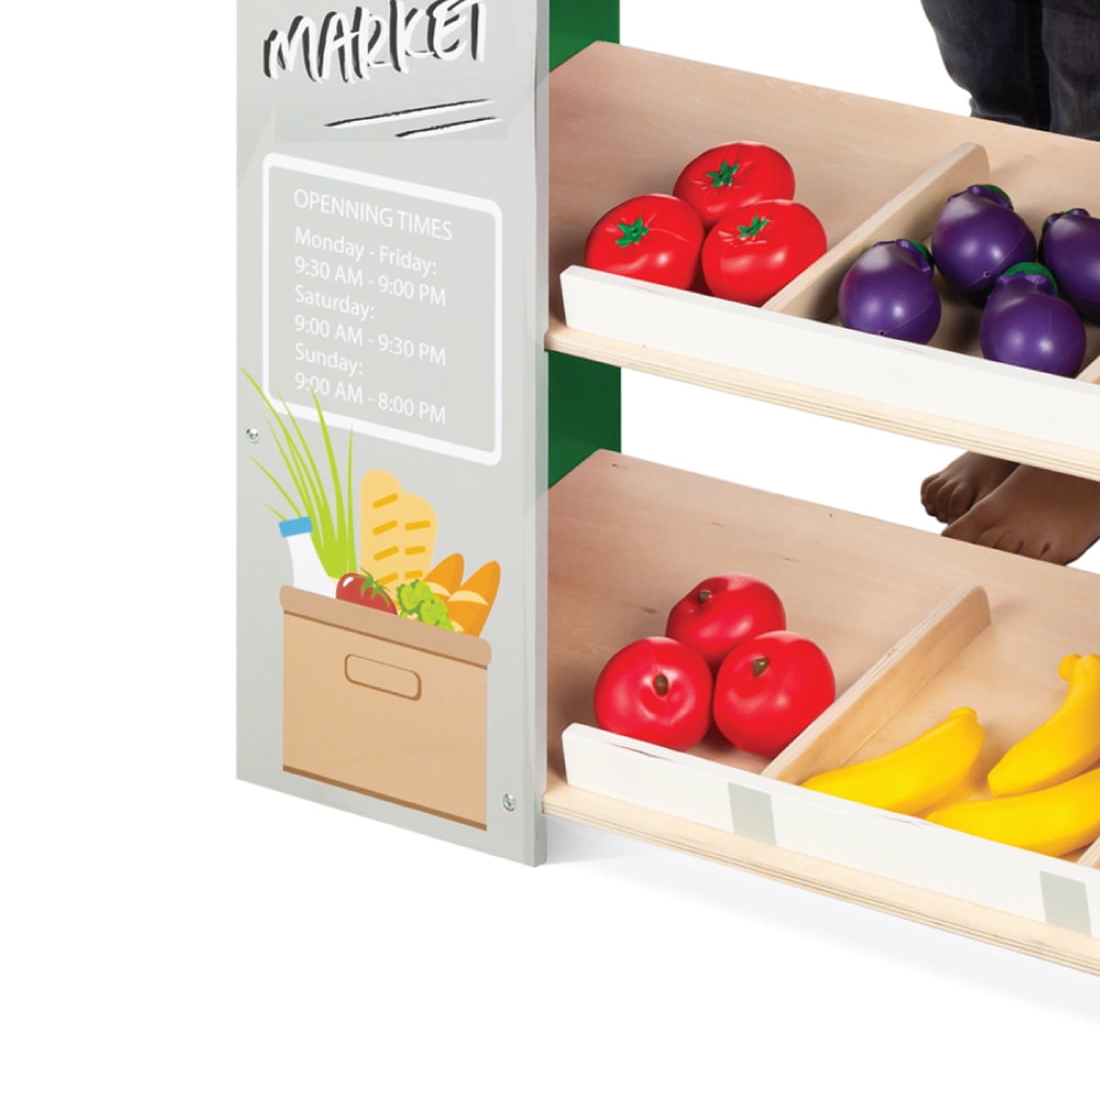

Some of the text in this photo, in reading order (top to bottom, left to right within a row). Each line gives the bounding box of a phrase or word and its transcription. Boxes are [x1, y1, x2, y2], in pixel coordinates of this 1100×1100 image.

[293, 188, 453, 241] OPENNING TIMES
[295, 226, 365, 262] Monday
[379, 245, 437, 277] Friday:
[295, 255, 331, 280] 9:30
[334, 264, 364, 288] AM
[378, 274, 415, 299] 9:00
[419, 283, 446, 308] PM
[295, 284, 375, 321] Saturday:
[295, 313, 331, 338] 9:00
[334, 323, 364, 347] AM
[378, 333, 415, 358] 9:30
[419, 342, 446, 367] PM
[295, 342, 363, 377] Sunday:
[295, 371, 331, 396] 9:00
[334, 381, 364, 405] AM
[378, 391, 415, 417] 8:00
[419, 401, 446, 425] PM
